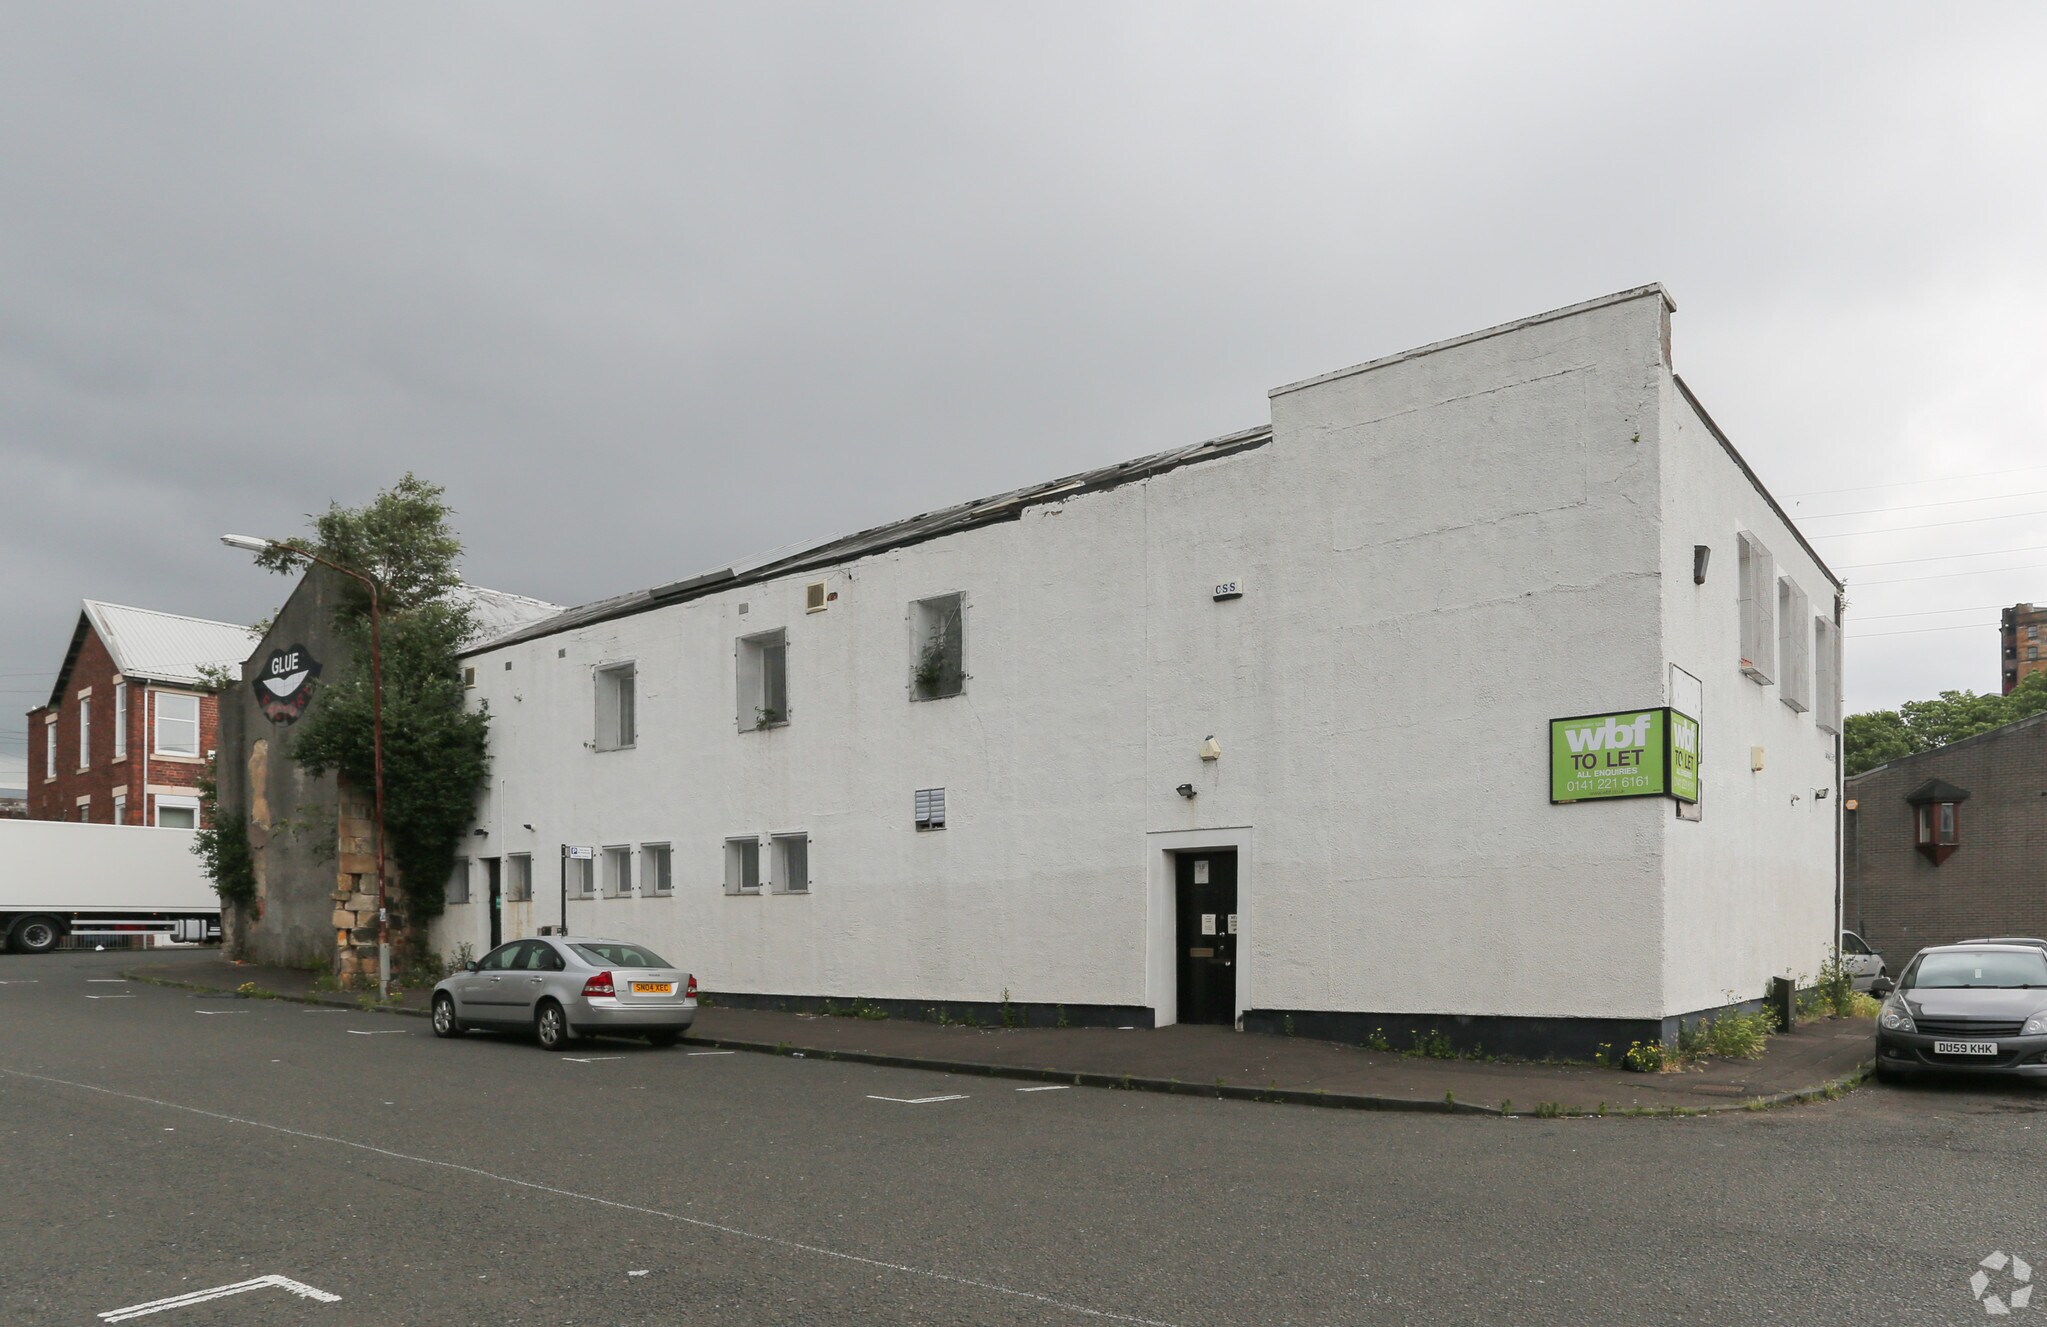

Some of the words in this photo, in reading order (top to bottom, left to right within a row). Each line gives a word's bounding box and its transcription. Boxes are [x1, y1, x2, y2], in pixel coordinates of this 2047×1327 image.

[271, 652, 299, 675] GLUE
[1564, 714, 1651, 752] wbf
[1673, 719, 1696, 754] wbf
[1570, 753, 1597, 770] TO
[1606, 749, 1644, 768] LET
[1675, 750, 1684, 767] TO
[1685, 753, 1694, 770] LET
[1594, 767, 1638, 777] ENQUIRIES
[1567, 780, 1593, 792] 0141
[1597, 778, 1617, 790] 221
[1621, 776, 1649, 788] 6161
[636, 983, 654, 991] SN04
[1939, 1043, 1968, 1053] DU59
[1970, 1043, 1992, 1053] KHK
